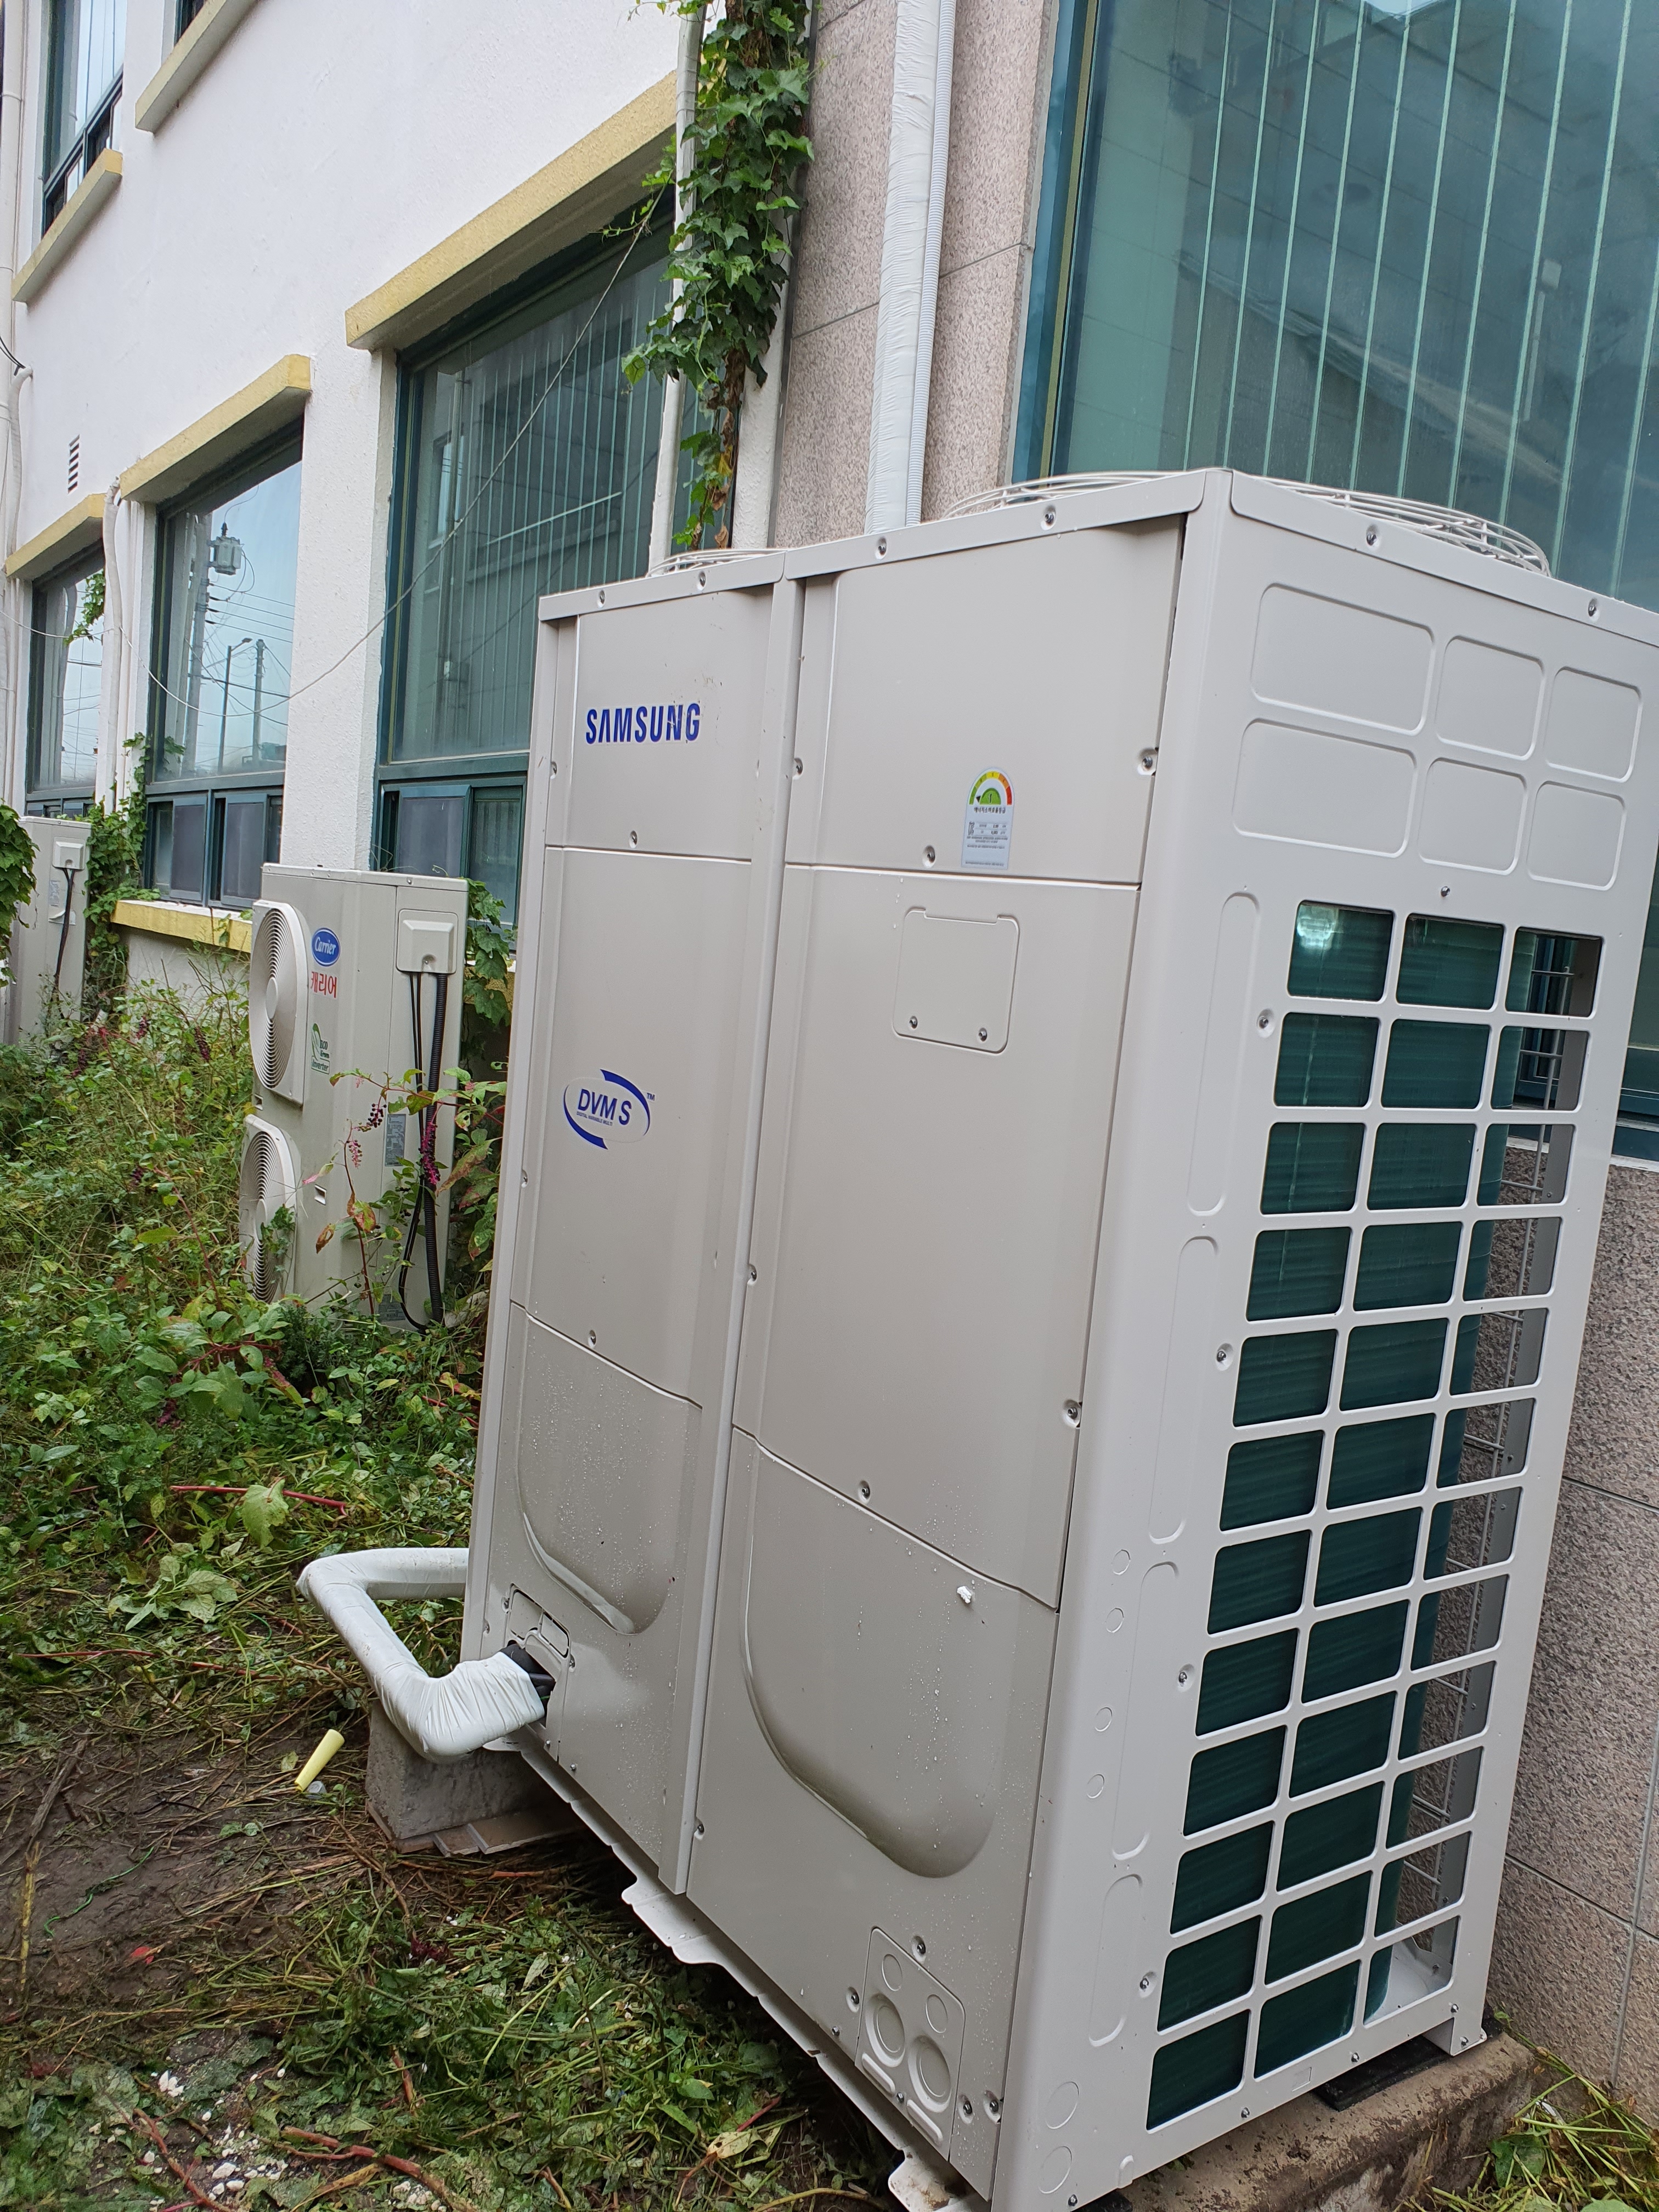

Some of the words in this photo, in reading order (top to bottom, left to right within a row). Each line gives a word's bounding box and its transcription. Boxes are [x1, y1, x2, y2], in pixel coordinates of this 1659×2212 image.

[585, 703, 701, 744] SAMSUNG
[315, 936, 336, 955] Carrier
[311, 971, 337, 998] 캐리어
[578, 1088, 618, 1120] DVM
[618, 1100, 632, 1125] S
